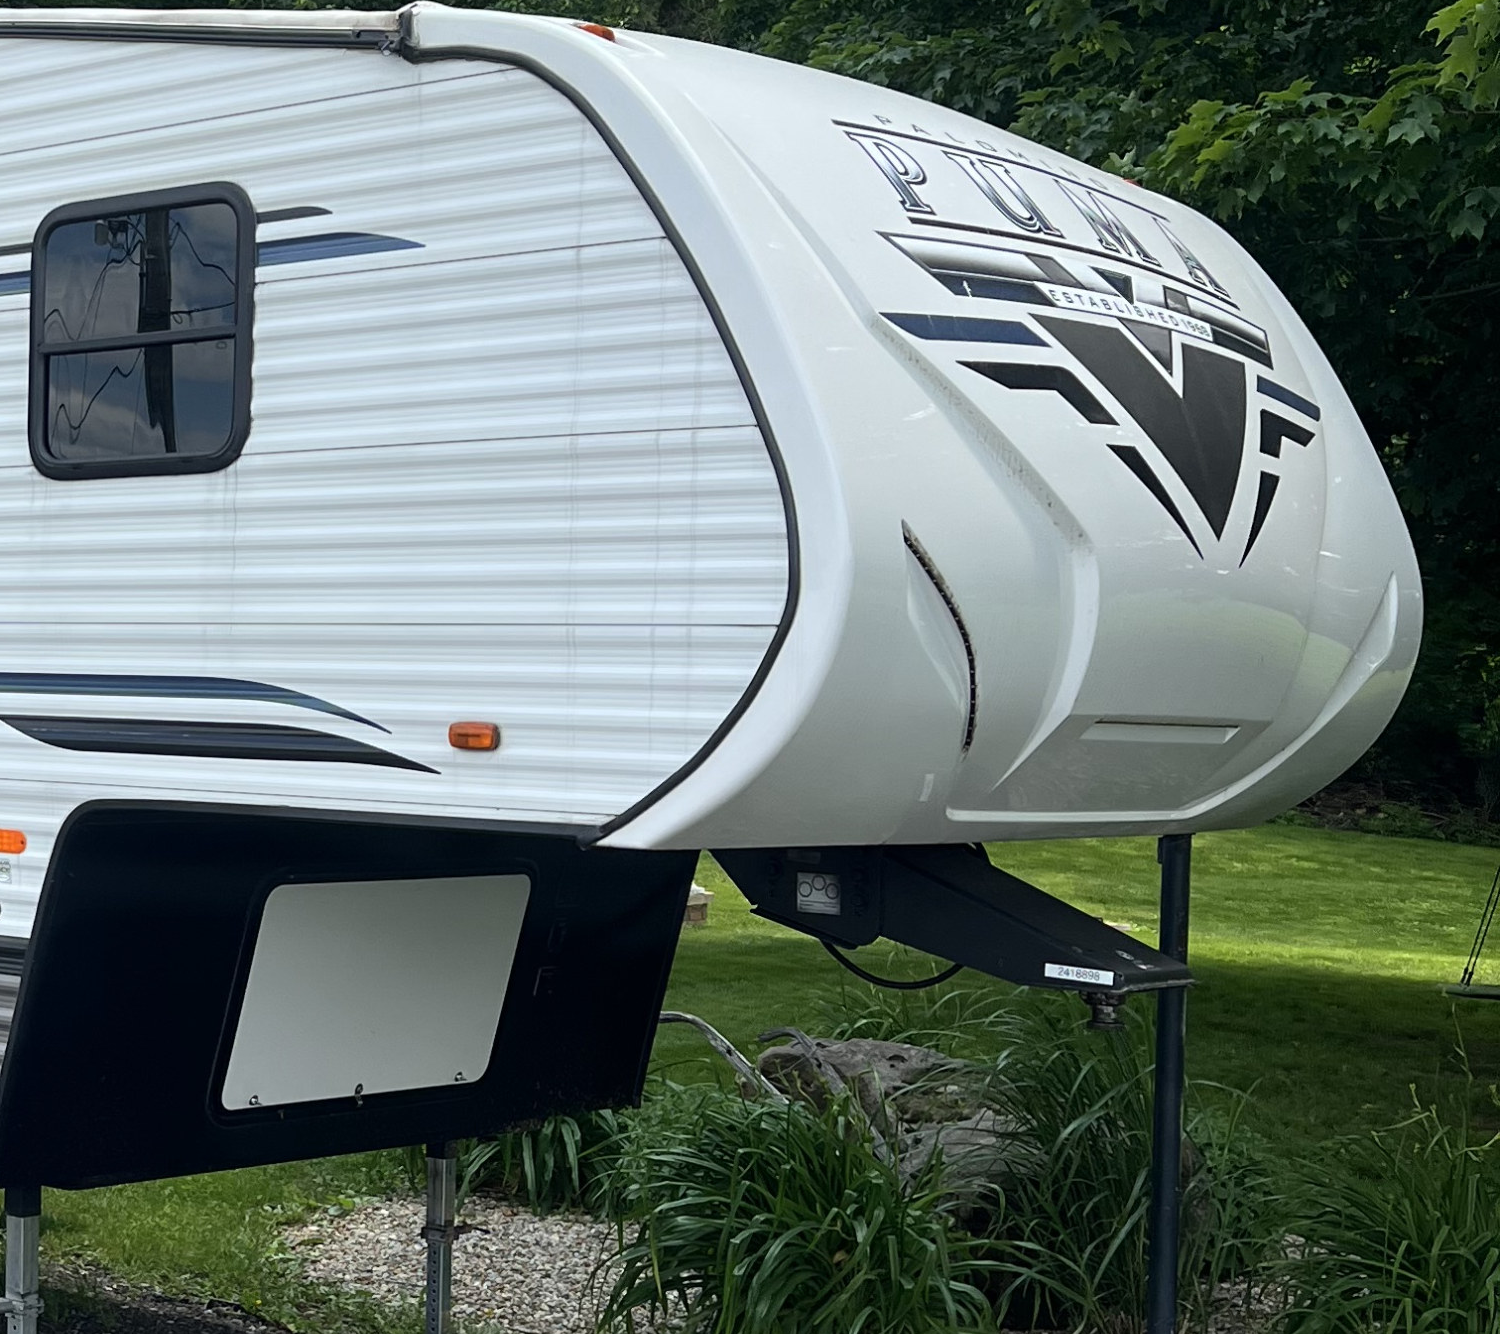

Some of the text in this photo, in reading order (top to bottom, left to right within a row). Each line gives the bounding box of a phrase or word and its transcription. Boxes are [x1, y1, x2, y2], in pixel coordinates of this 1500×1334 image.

[843, 131, 1233, 299] PUMA
[1049, 289, 1180, 327] ESTABLISHED
[1057, 967, 1101, 982] 2418898
